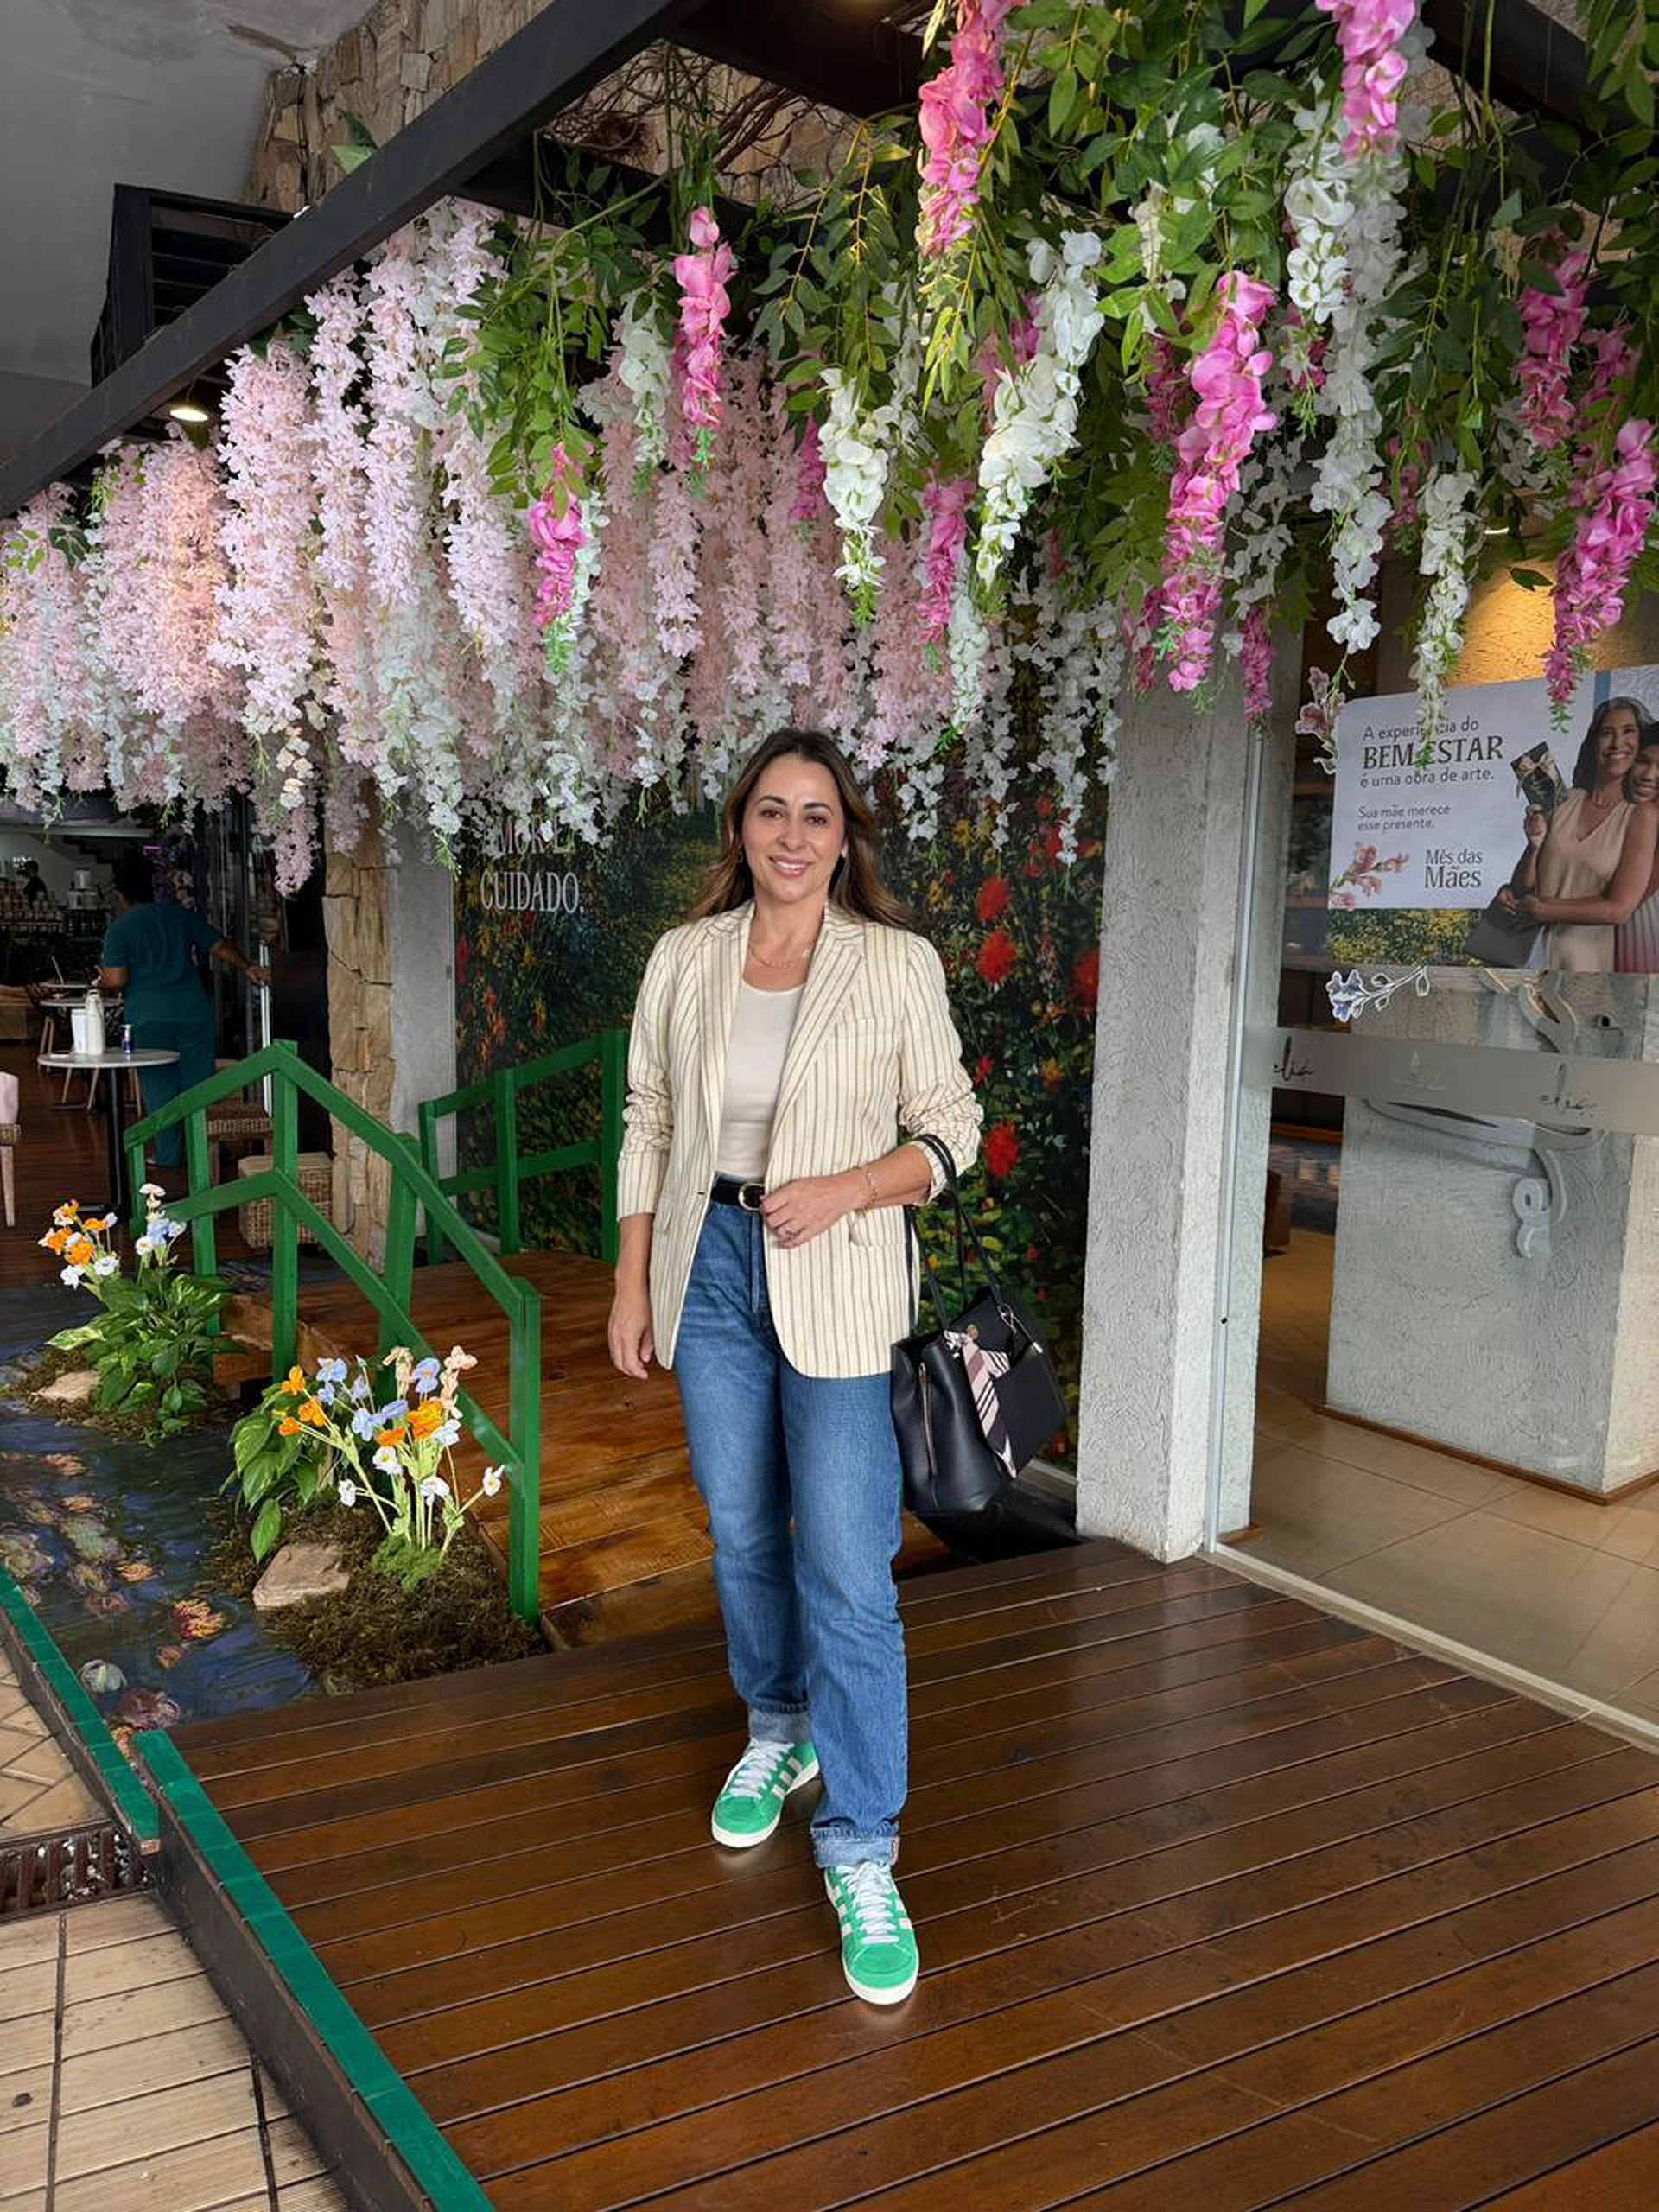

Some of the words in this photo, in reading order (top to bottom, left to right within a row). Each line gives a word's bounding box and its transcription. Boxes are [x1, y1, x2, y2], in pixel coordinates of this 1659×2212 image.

[1363, 725, 1375, 741] A
[1461, 715, 1479, 731] do
[1372, 775, 1401, 787] uma
[1405, 771, 1435, 785] obra
[1440, 766, 1458, 783] de
[1461, 768, 1494, 782] arte.
[1357, 805, 1378, 818] Sua
[1382, 804, 1404, 817] mãe
[1408, 804, 1452, 817] merece
[1357, 822, 1380, 831] esse
[1382, 819, 1435, 833] presente.
[1427, 848, 1453, 865] Mês
[1458, 848, 1483, 864] das
[1425, 866, 1482, 889] Mães
[480, 871, 584, 914] CUIDADO.
